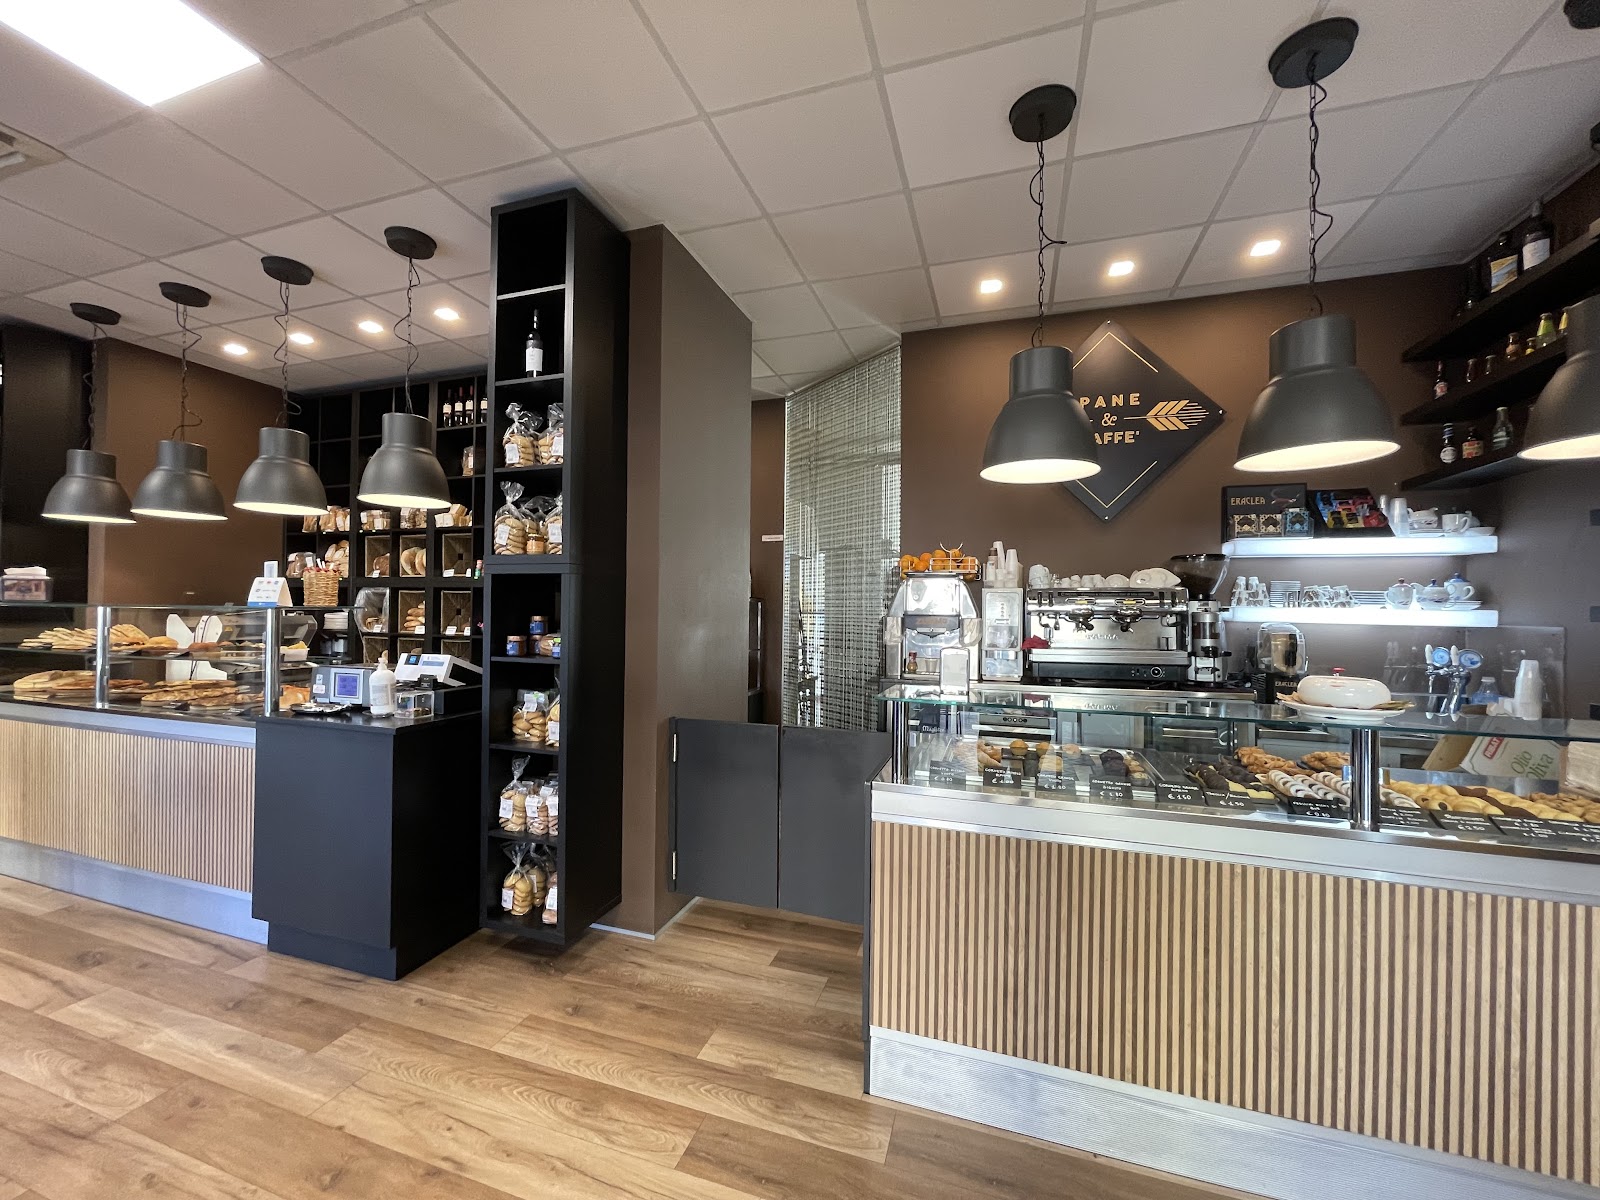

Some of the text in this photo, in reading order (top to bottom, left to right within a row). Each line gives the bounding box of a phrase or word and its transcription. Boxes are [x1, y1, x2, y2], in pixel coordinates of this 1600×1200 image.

[1079, 392, 1141, 409] PANE
[1101, 412, 1117, 427] &
[1094, 430, 1140, 445] AFFE'
[1231, 497, 1265, 506] ERACLEA
[1510, 751, 1532, 774] Olio
